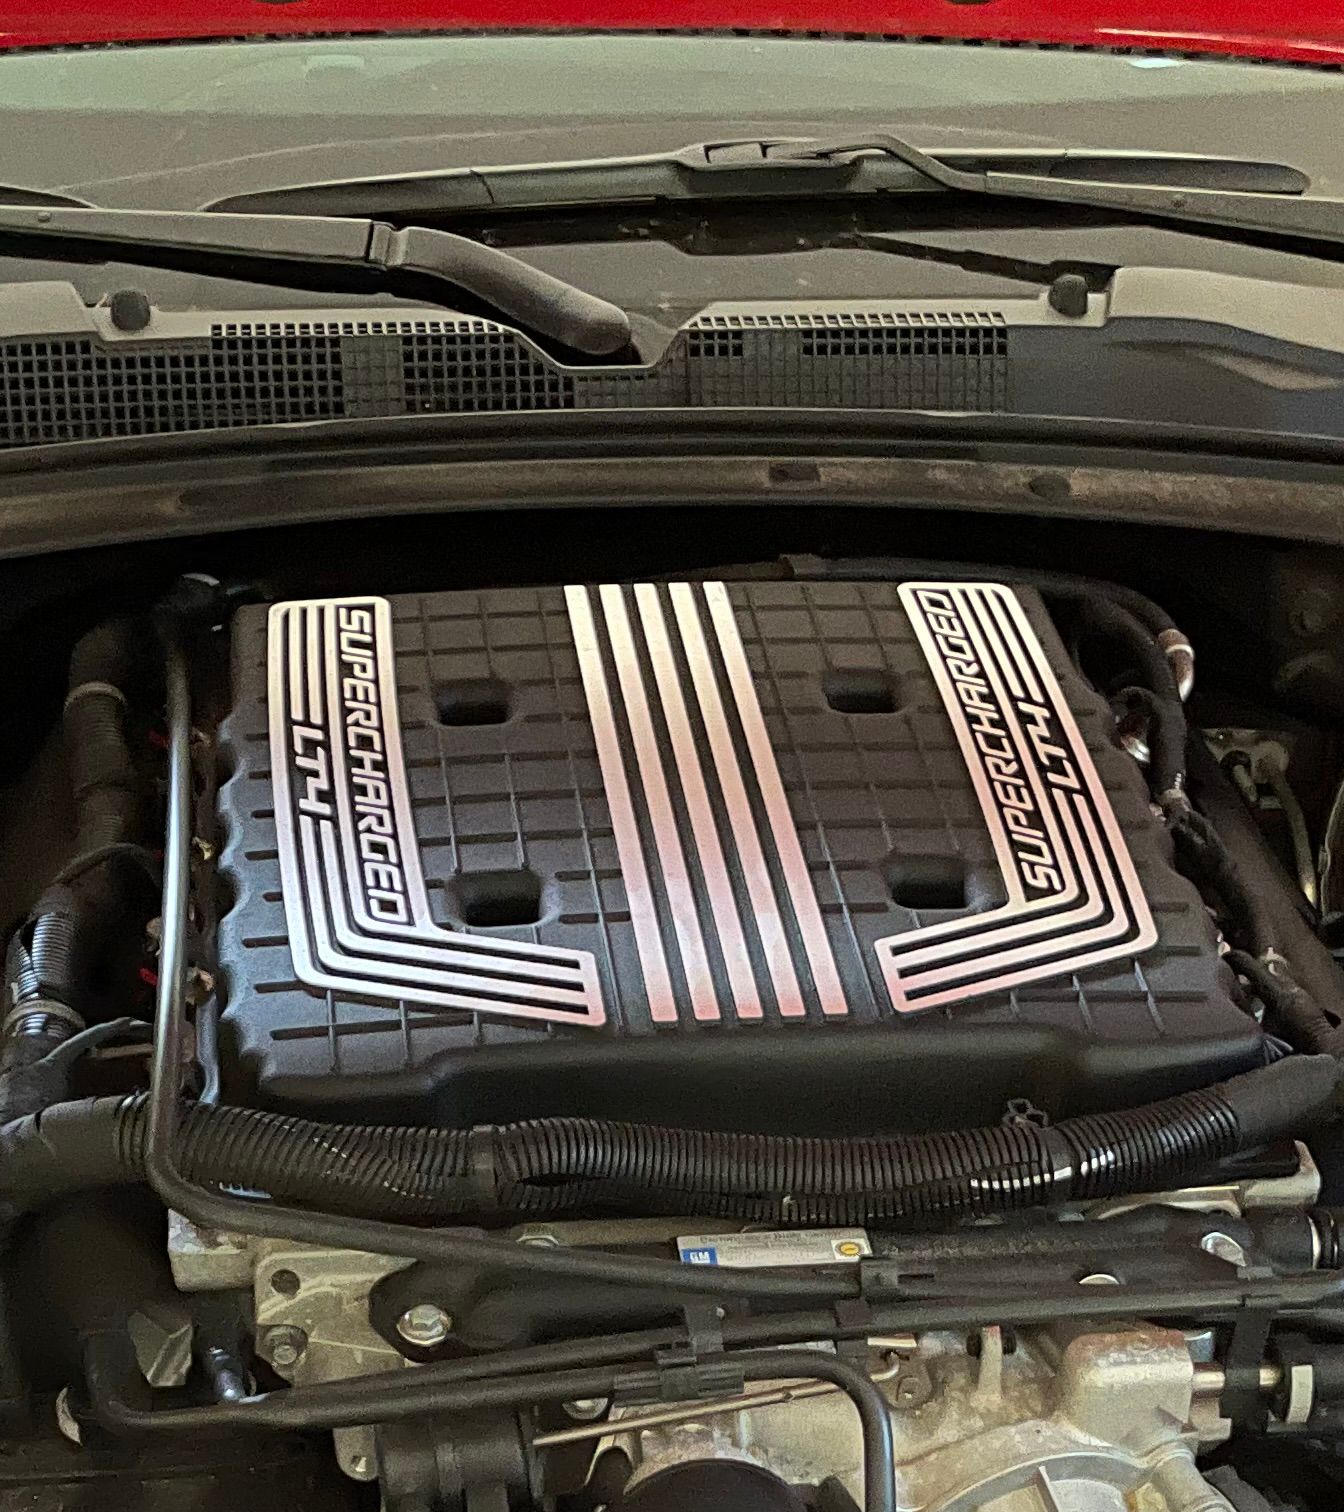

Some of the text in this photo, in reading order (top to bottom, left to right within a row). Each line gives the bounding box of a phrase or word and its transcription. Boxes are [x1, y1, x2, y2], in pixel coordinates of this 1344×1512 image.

[291, 723, 331, 816] LT4
[339, 607, 408, 924] SUPERCHARGED
[917, 590, 1062, 892] SUPERCHARGED
[1018, 701, 1082, 791] LT4
